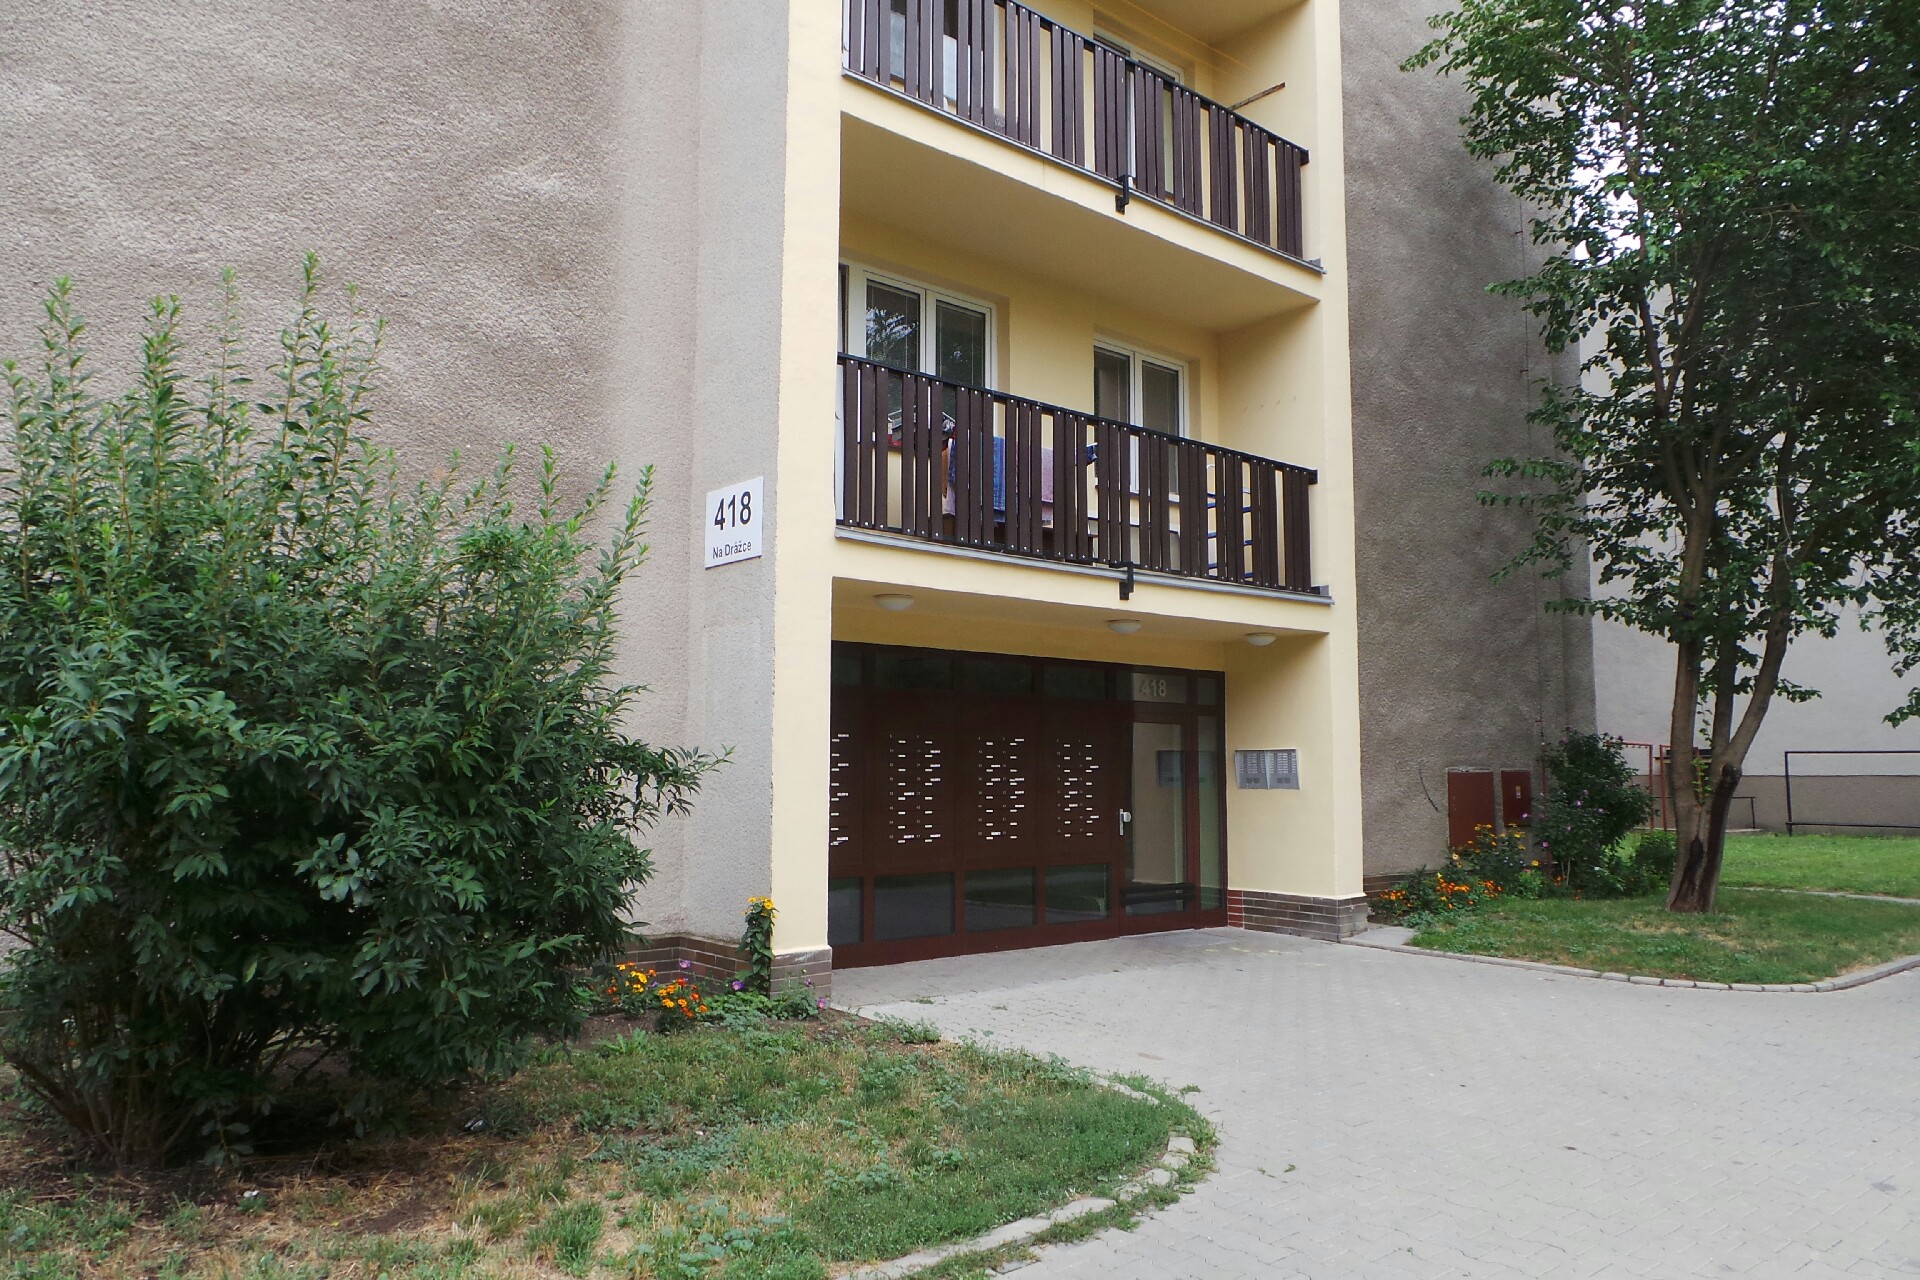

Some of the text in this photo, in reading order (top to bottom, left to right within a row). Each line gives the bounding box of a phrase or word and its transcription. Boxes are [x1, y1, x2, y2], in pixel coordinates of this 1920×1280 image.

[714, 491, 752, 530] 418
[713, 541, 752, 559] Na Drážce
[1141, 680, 1167, 697] 418
